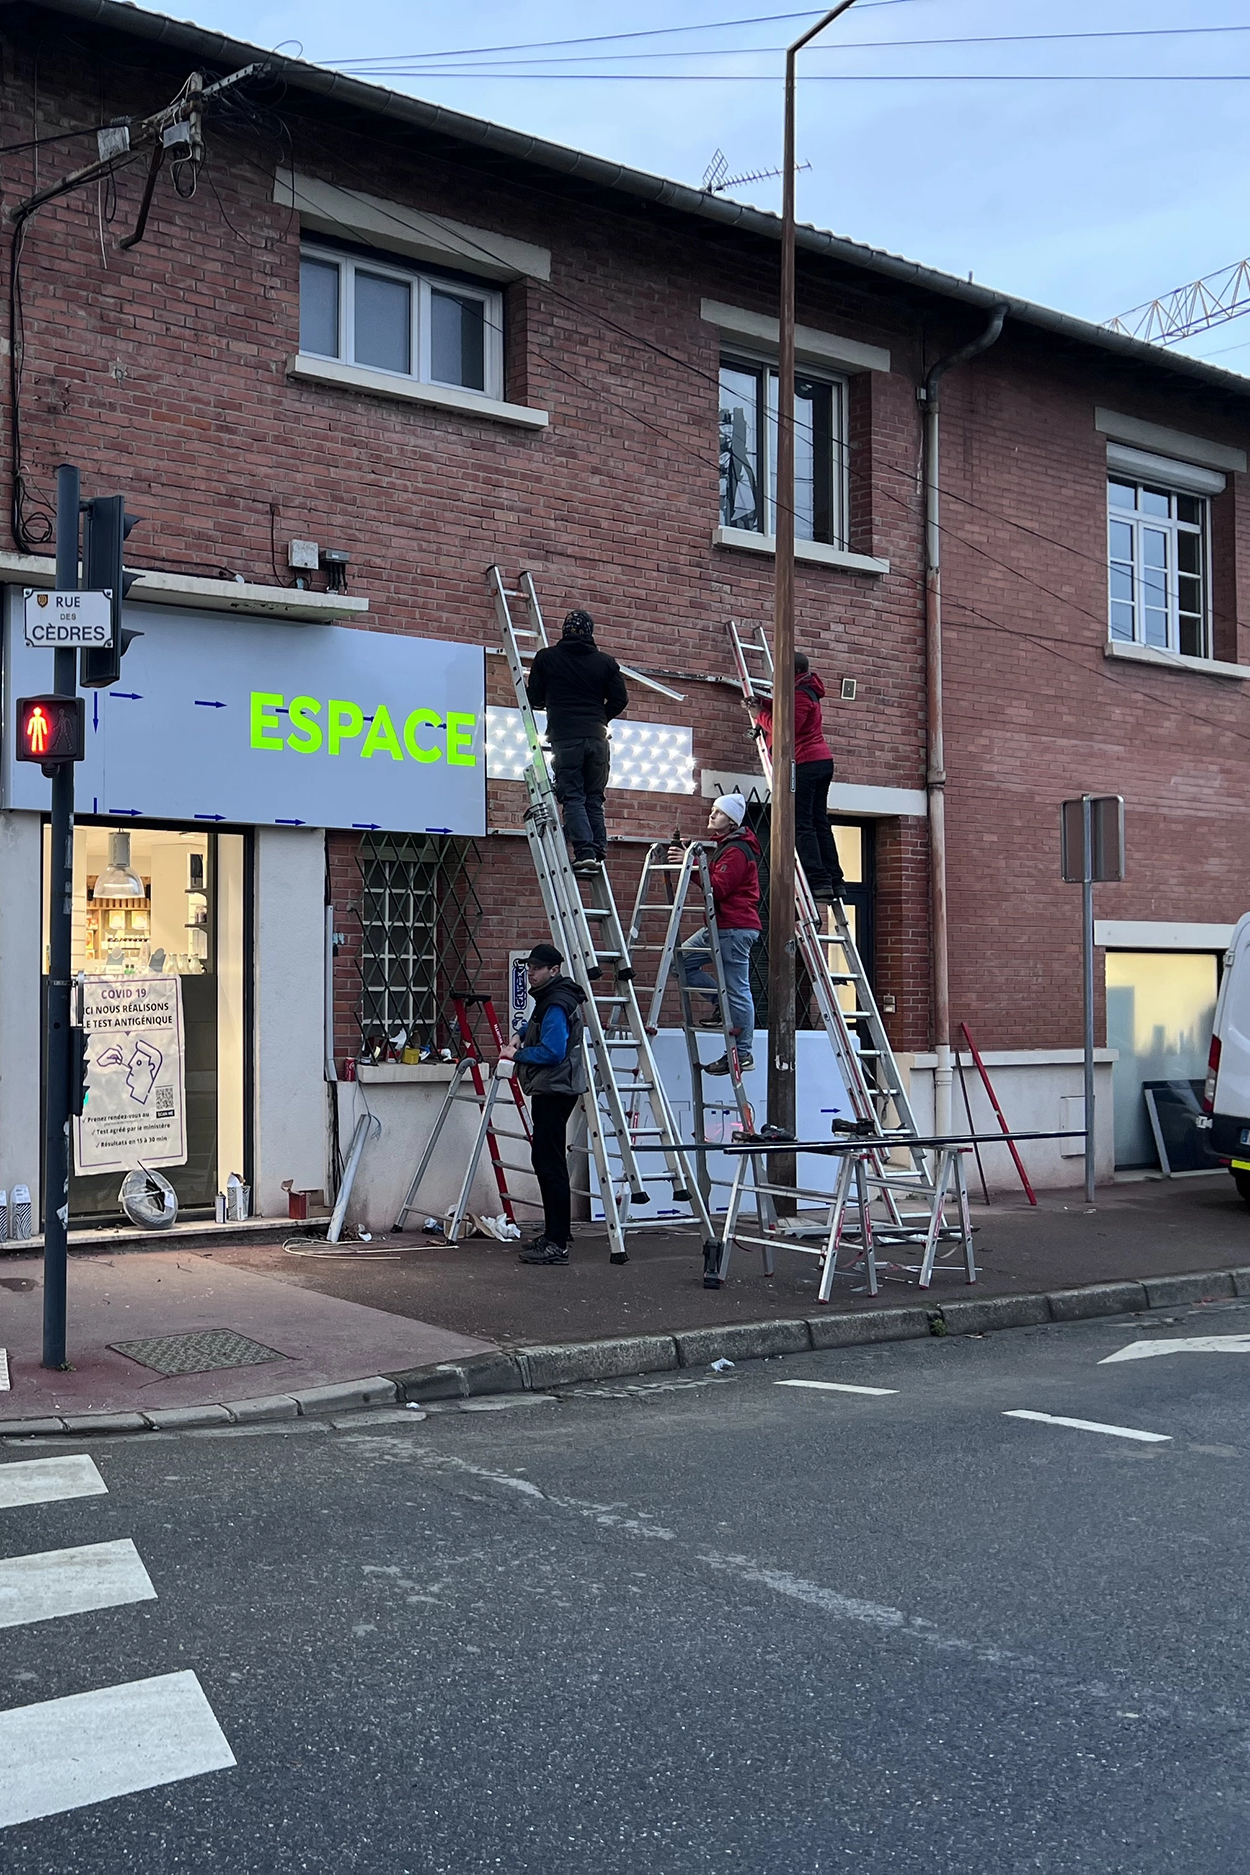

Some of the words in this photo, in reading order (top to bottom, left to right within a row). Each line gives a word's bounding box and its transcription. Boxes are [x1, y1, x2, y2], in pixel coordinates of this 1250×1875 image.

[56, 596, 80, 608] RUE
[32, 623, 105, 641] CÈDRES
[250, 691, 477, 767] ESPACE
[102, 990, 132, 999] COVID
[136, 988, 147, 998] 19
[96, 1005, 120, 1014] NOUS
[122, 1002, 169, 1013] RÉALISONS
[93, 1019, 112, 1028] TEST
[114, 1015, 172, 1027] ANTIGÉNIQUE
[108, 1112, 141, 1121] rendez-vous
[110, 1126, 125, 1134] agréé
